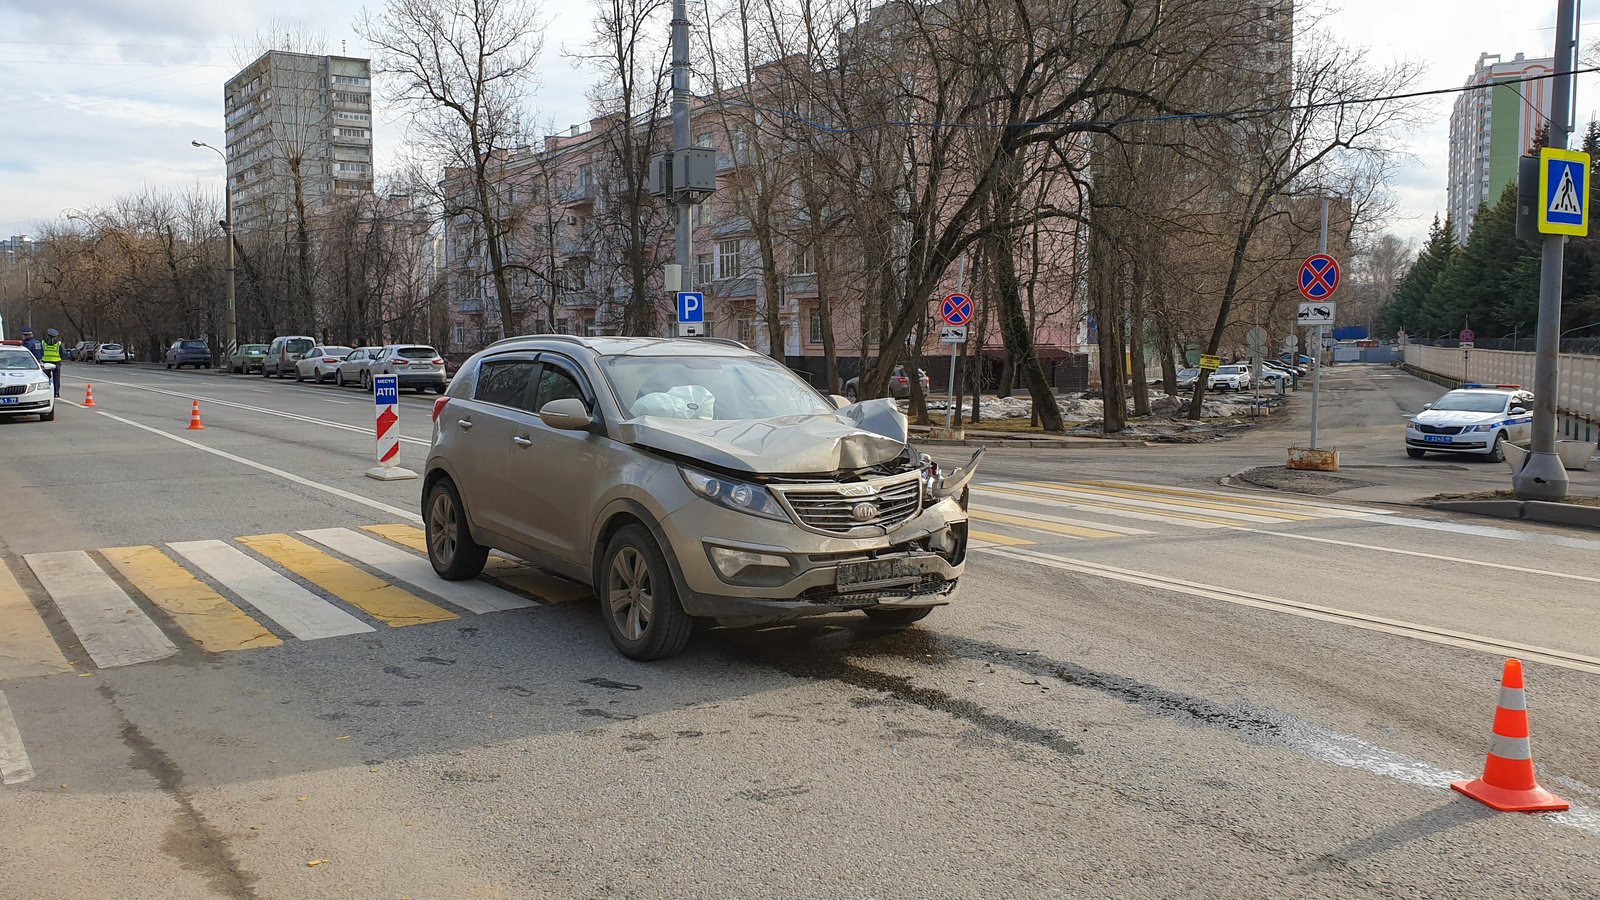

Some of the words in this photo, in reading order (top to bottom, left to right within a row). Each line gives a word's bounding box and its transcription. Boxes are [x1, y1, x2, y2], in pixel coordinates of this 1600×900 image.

[684, 295, 699, 320] P
[376, 387, 395, 397] ДТП
[857, 506, 874, 518] KIA
